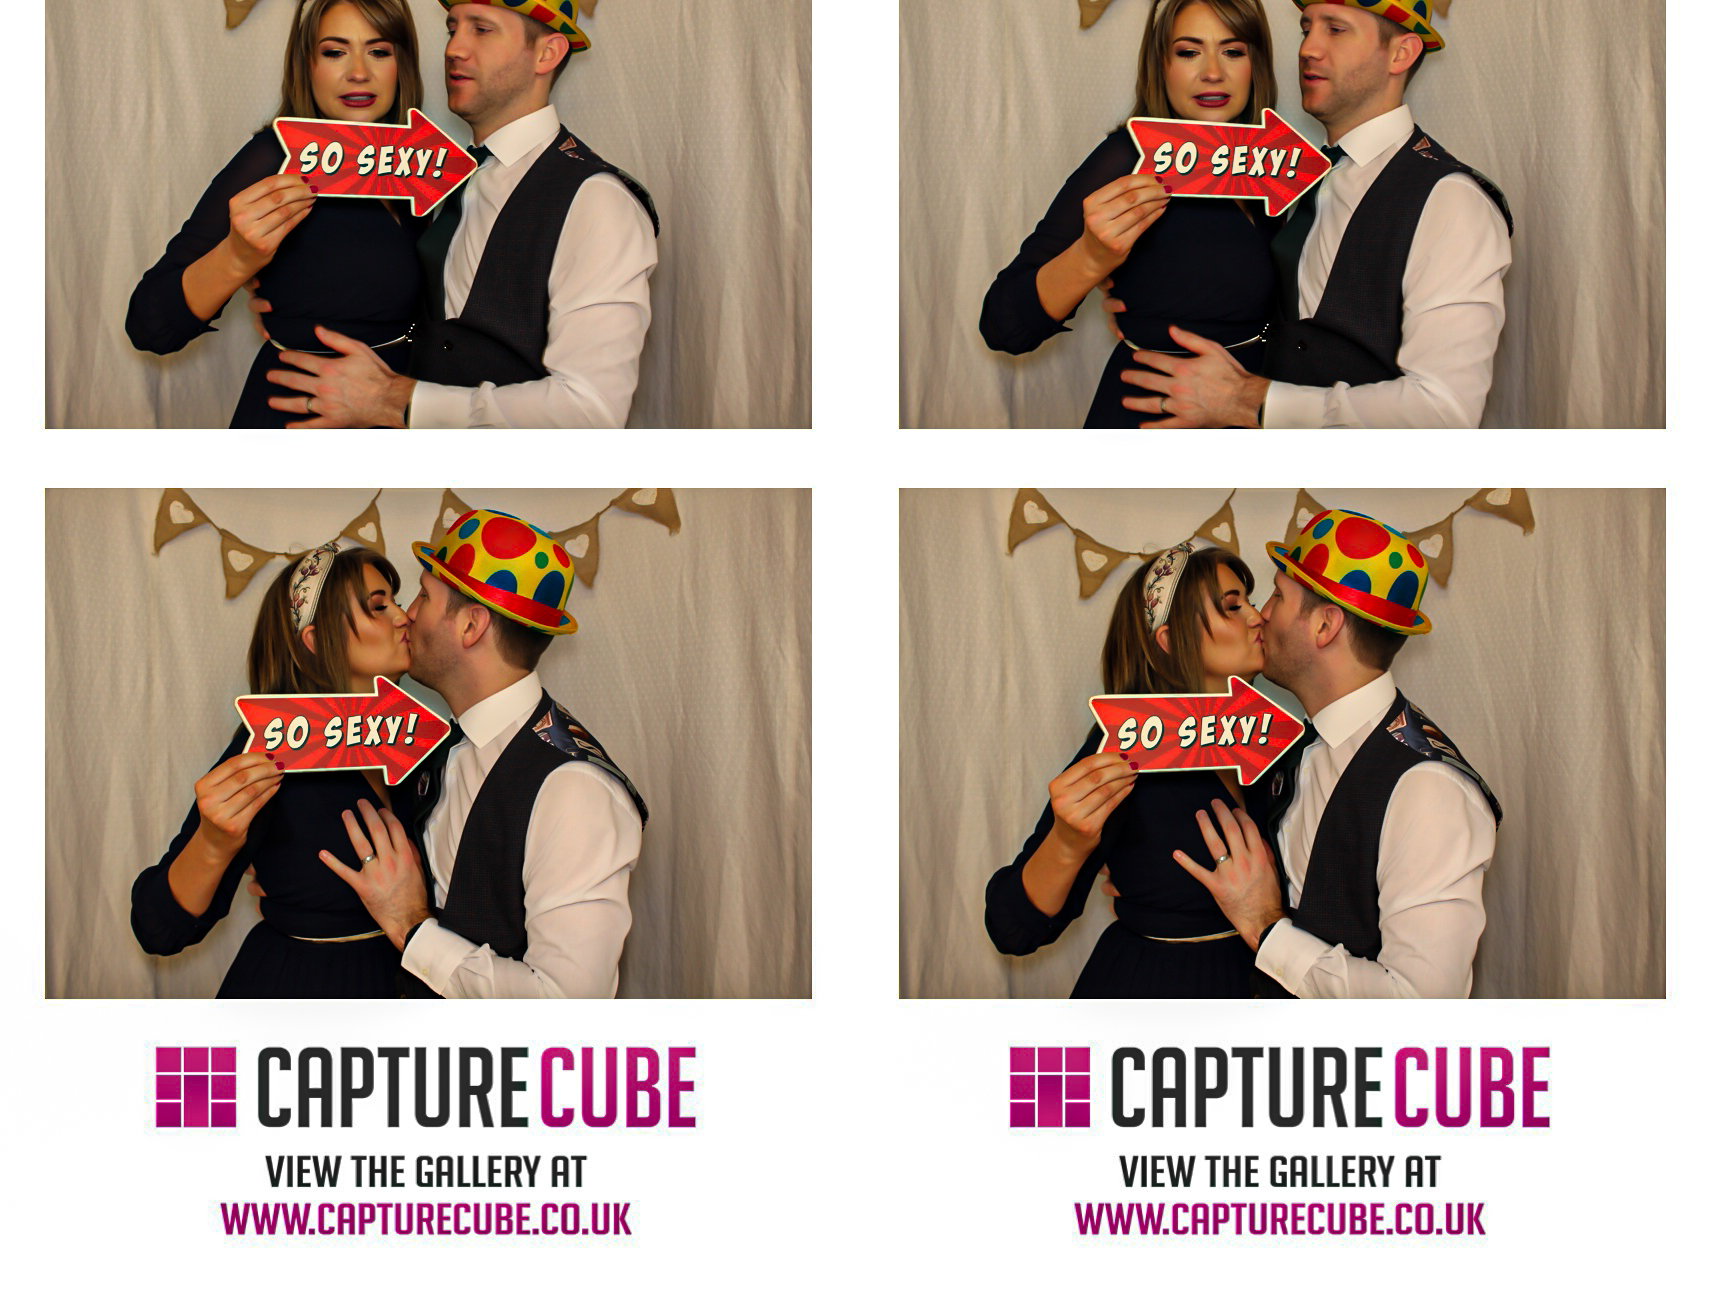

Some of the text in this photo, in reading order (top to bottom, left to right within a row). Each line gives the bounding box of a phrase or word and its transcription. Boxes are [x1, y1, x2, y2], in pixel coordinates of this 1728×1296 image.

[299, 141, 448, 179] SO SEXY!
[1153, 141, 1302, 179] SO SEXY!
[263, 713, 420, 751] SO SEXY!
[1117, 713, 1274, 751] SO SEXY!
